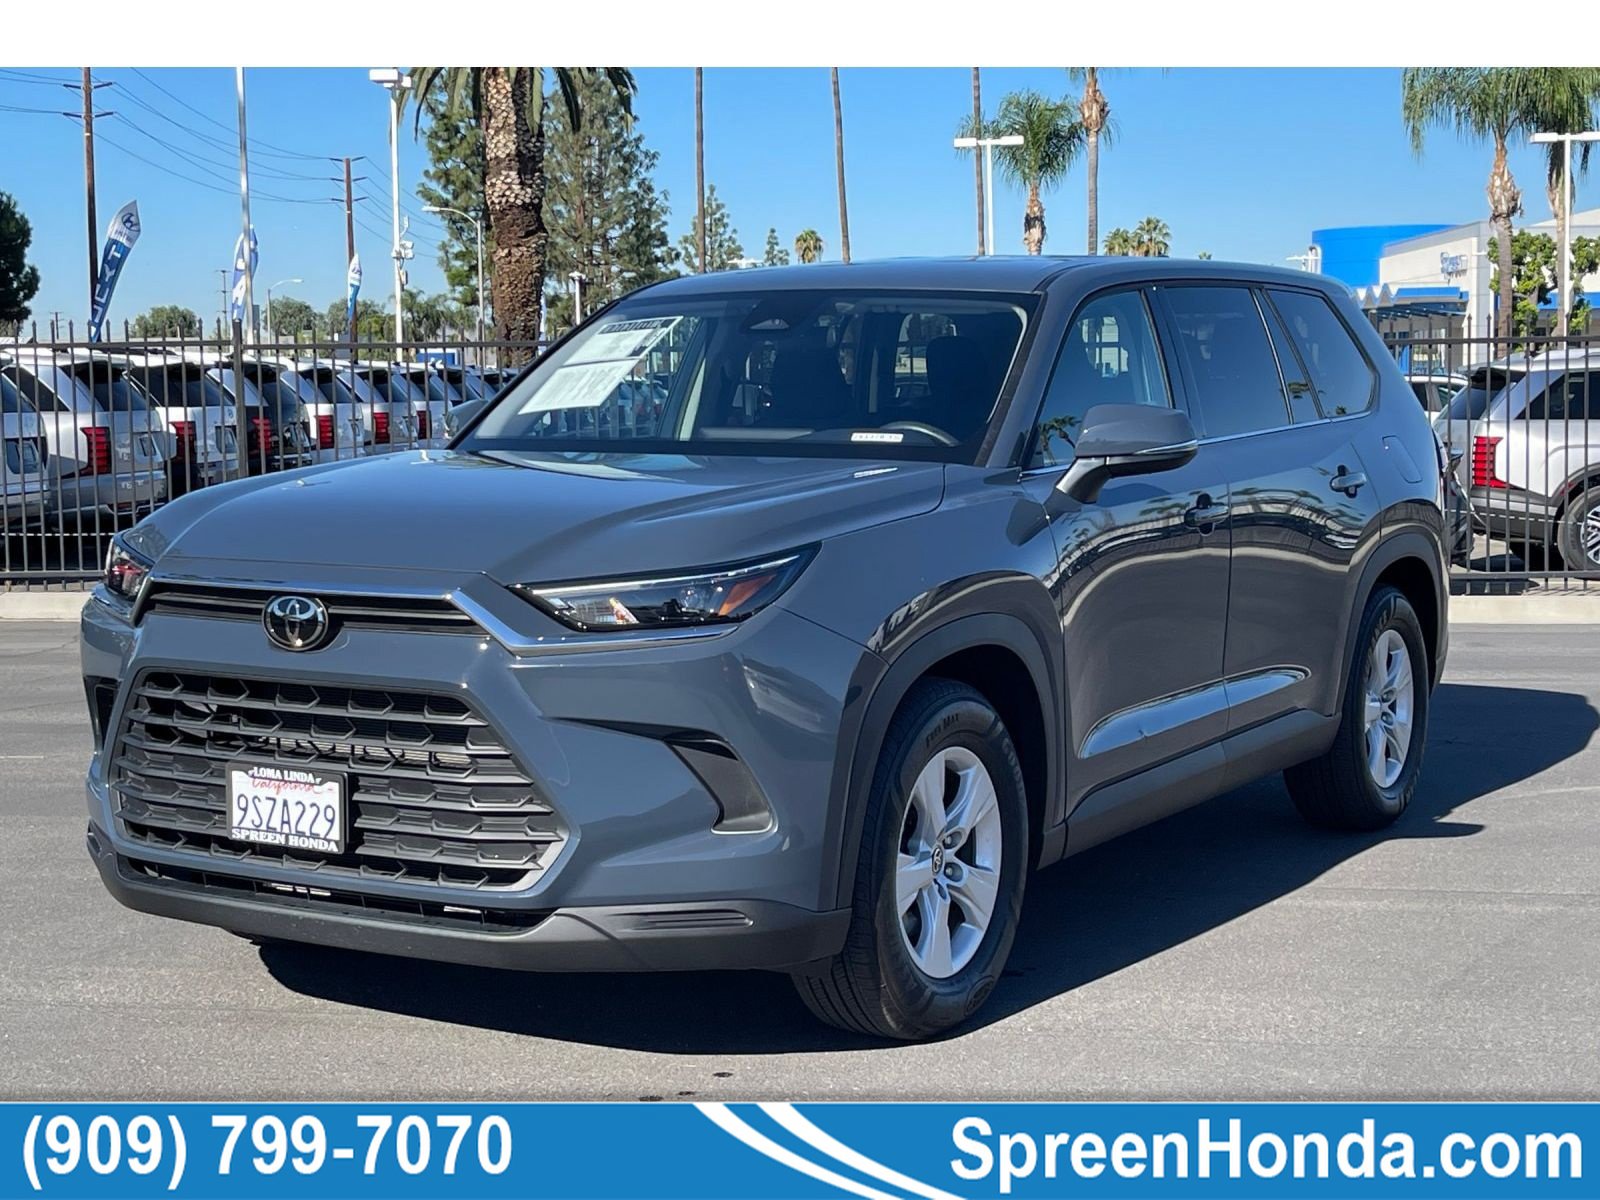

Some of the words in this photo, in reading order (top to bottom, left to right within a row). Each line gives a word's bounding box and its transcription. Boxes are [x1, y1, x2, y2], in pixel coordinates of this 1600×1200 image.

[253, 767, 282, 780] LOMA
[283, 770, 315, 784] LINDA
[237, 794, 336, 840] 9SZA229
[232, 828, 286, 845] SPREEN
[288, 834, 338, 852] HONDA
